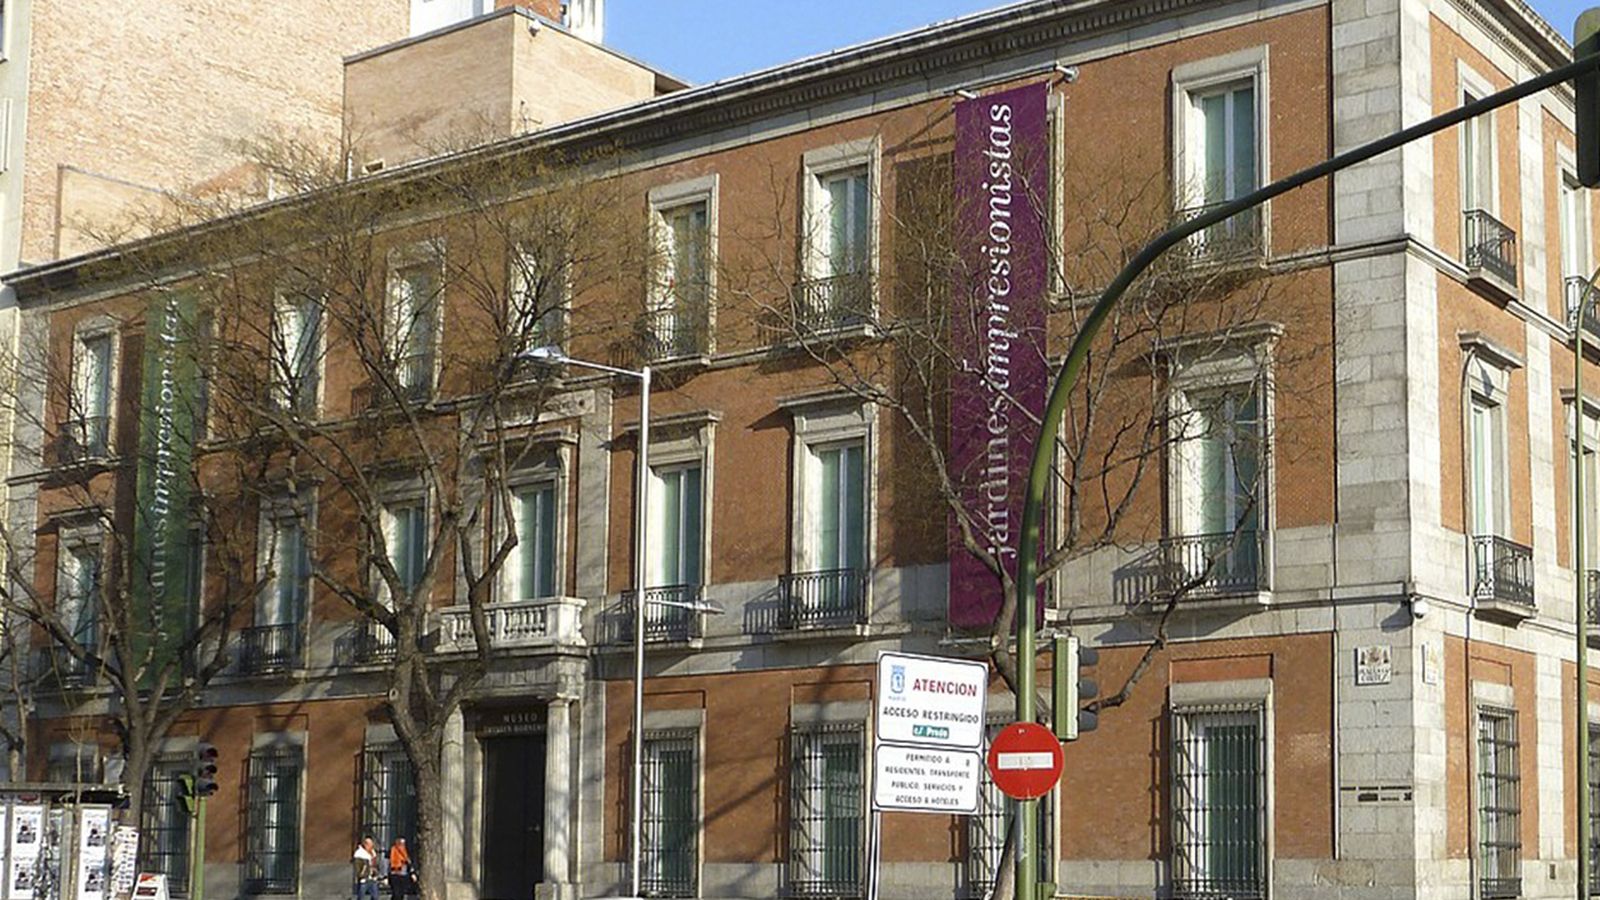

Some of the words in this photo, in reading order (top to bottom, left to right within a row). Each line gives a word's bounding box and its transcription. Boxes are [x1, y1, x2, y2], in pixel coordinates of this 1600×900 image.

[913, 678, 977, 697] ATENCION
[883, 706, 919, 720] ACCESO
[922, 710, 979, 724] RESTRINGIDO
[906, 753, 943, 764] PERMITIDO
[929, 769, 970, 779] TRANSPORTE
[923, 783, 956, 792] SERVICIOS
[895, 795, 922, 804] ACCESO
[931, 797, 959, 806] HOTELES
